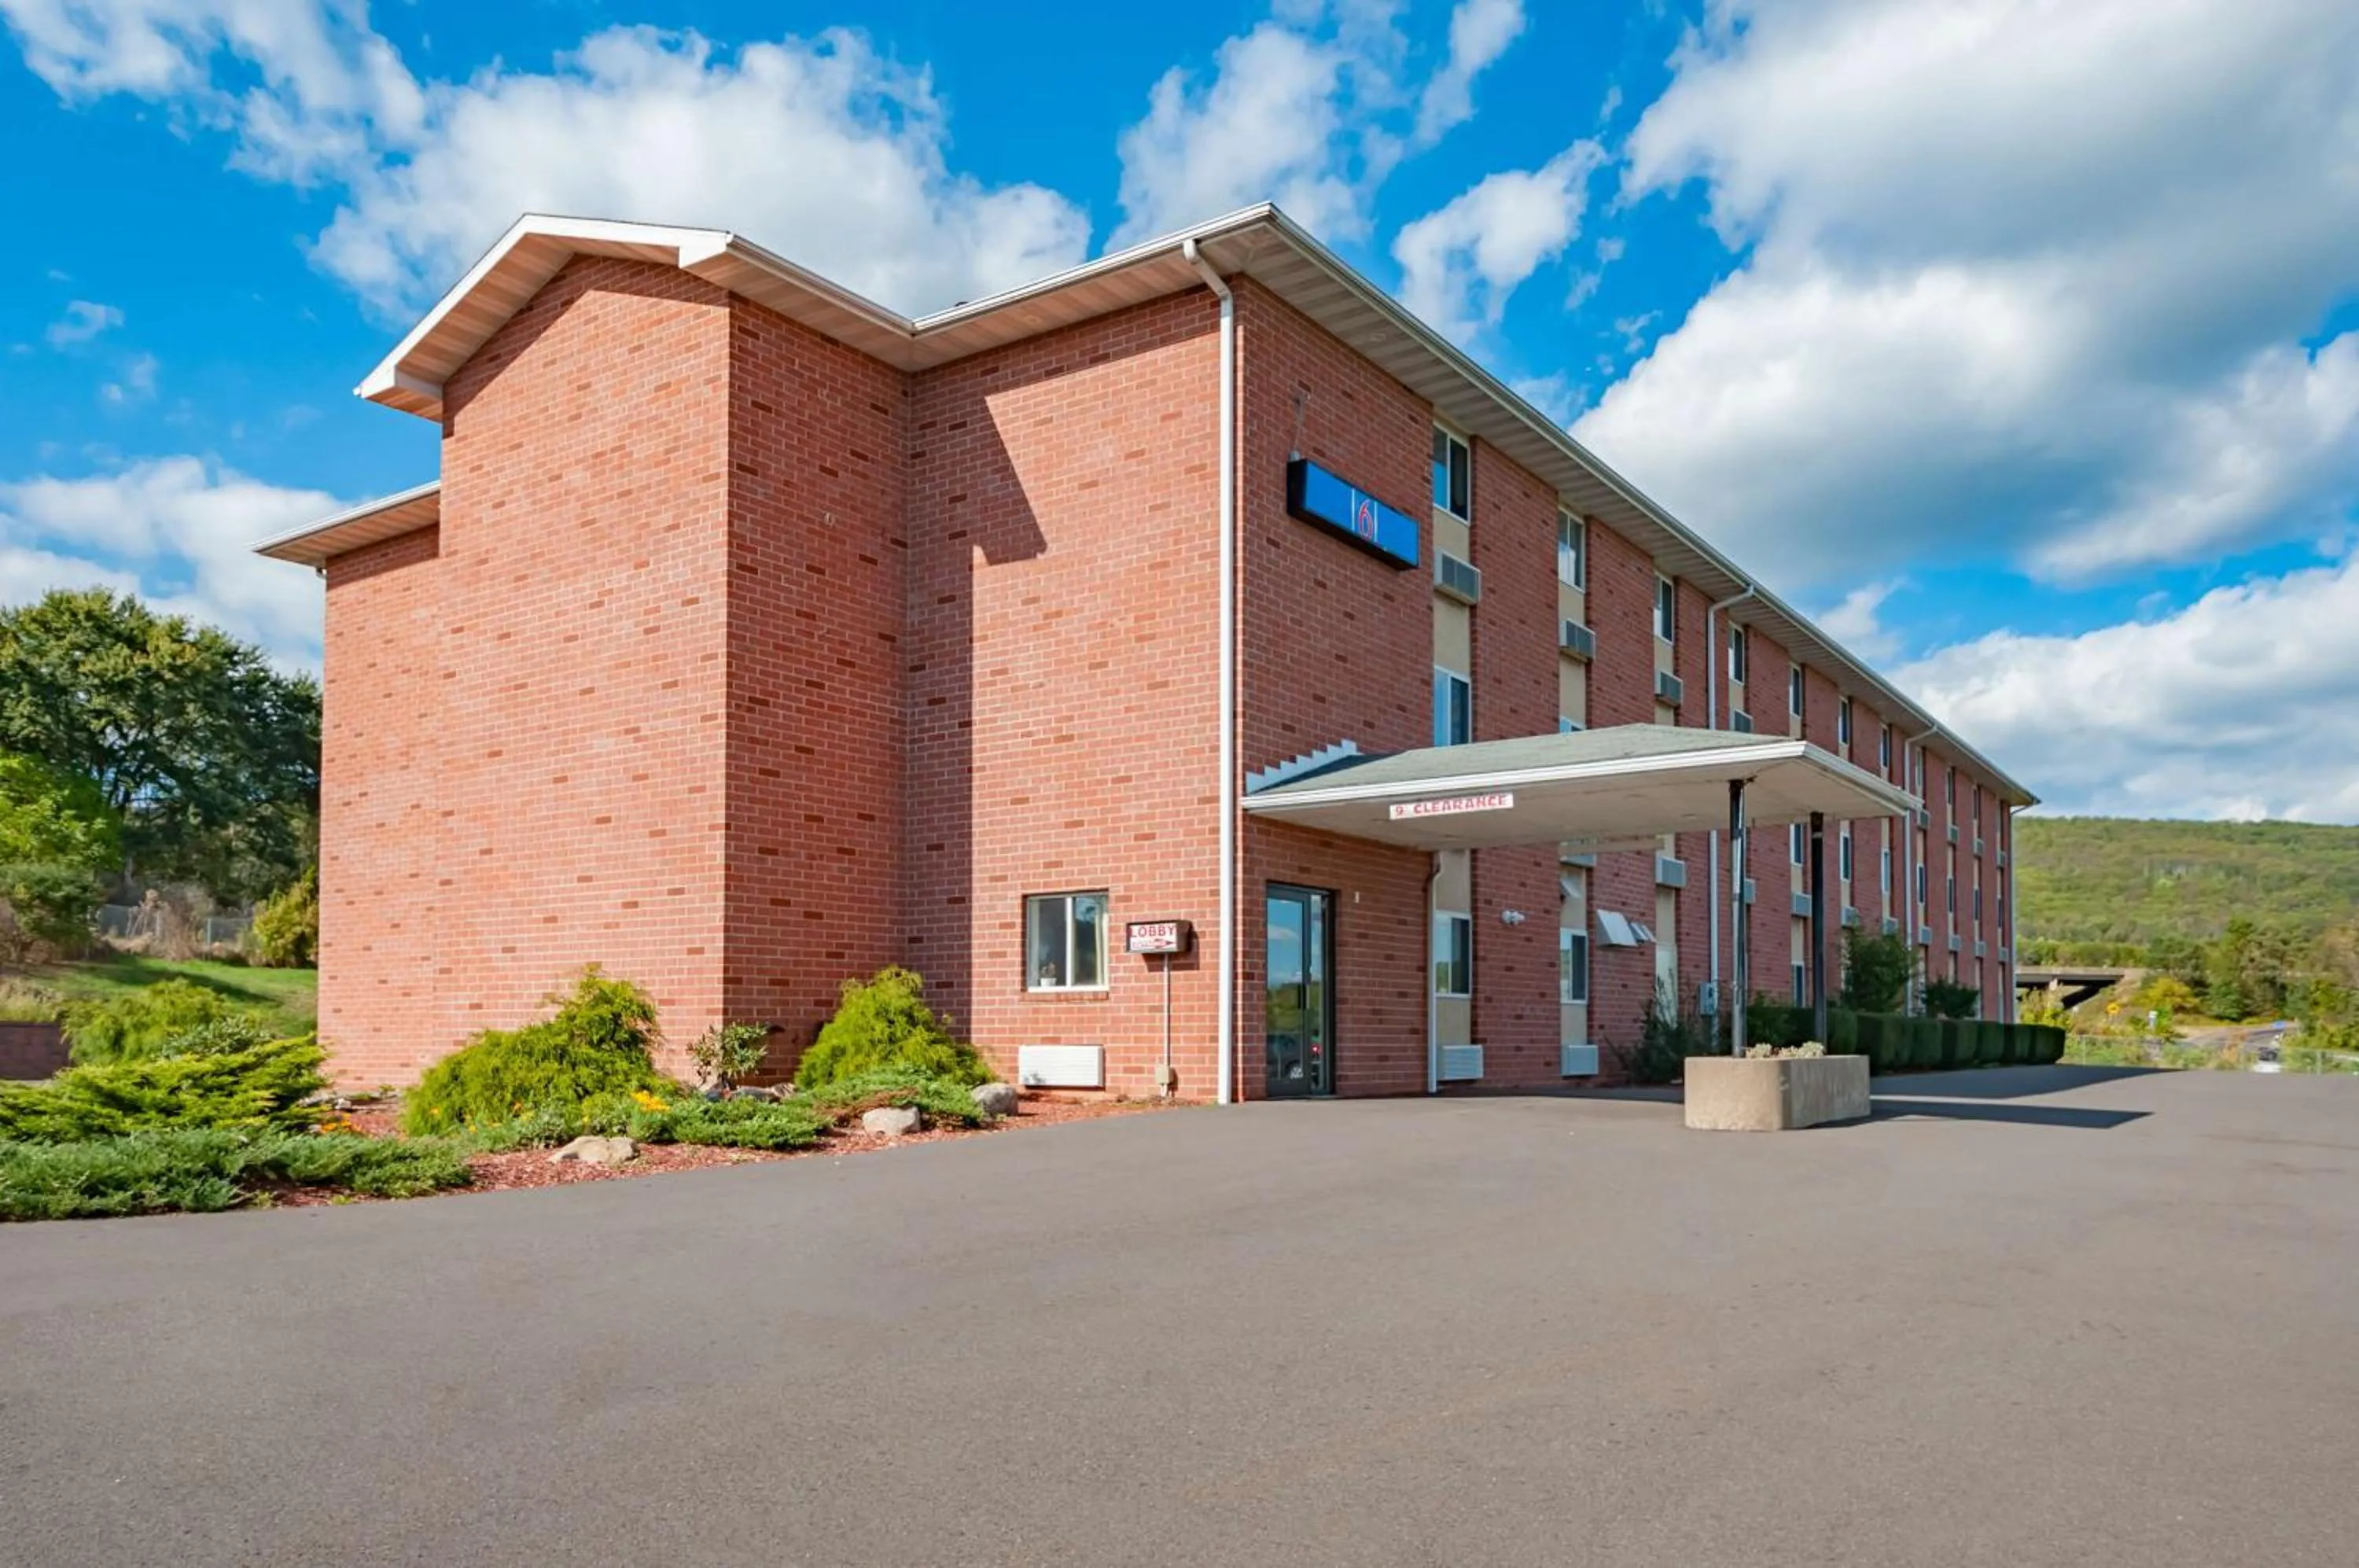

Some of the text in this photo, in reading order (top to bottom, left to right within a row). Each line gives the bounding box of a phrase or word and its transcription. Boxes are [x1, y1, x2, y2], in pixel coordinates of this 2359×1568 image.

[1358, 499, 1373, 539] 6
[1413, 793, 1507, 815] CLEARANCE
[1129, 924, 1175, 938] LOBBY
